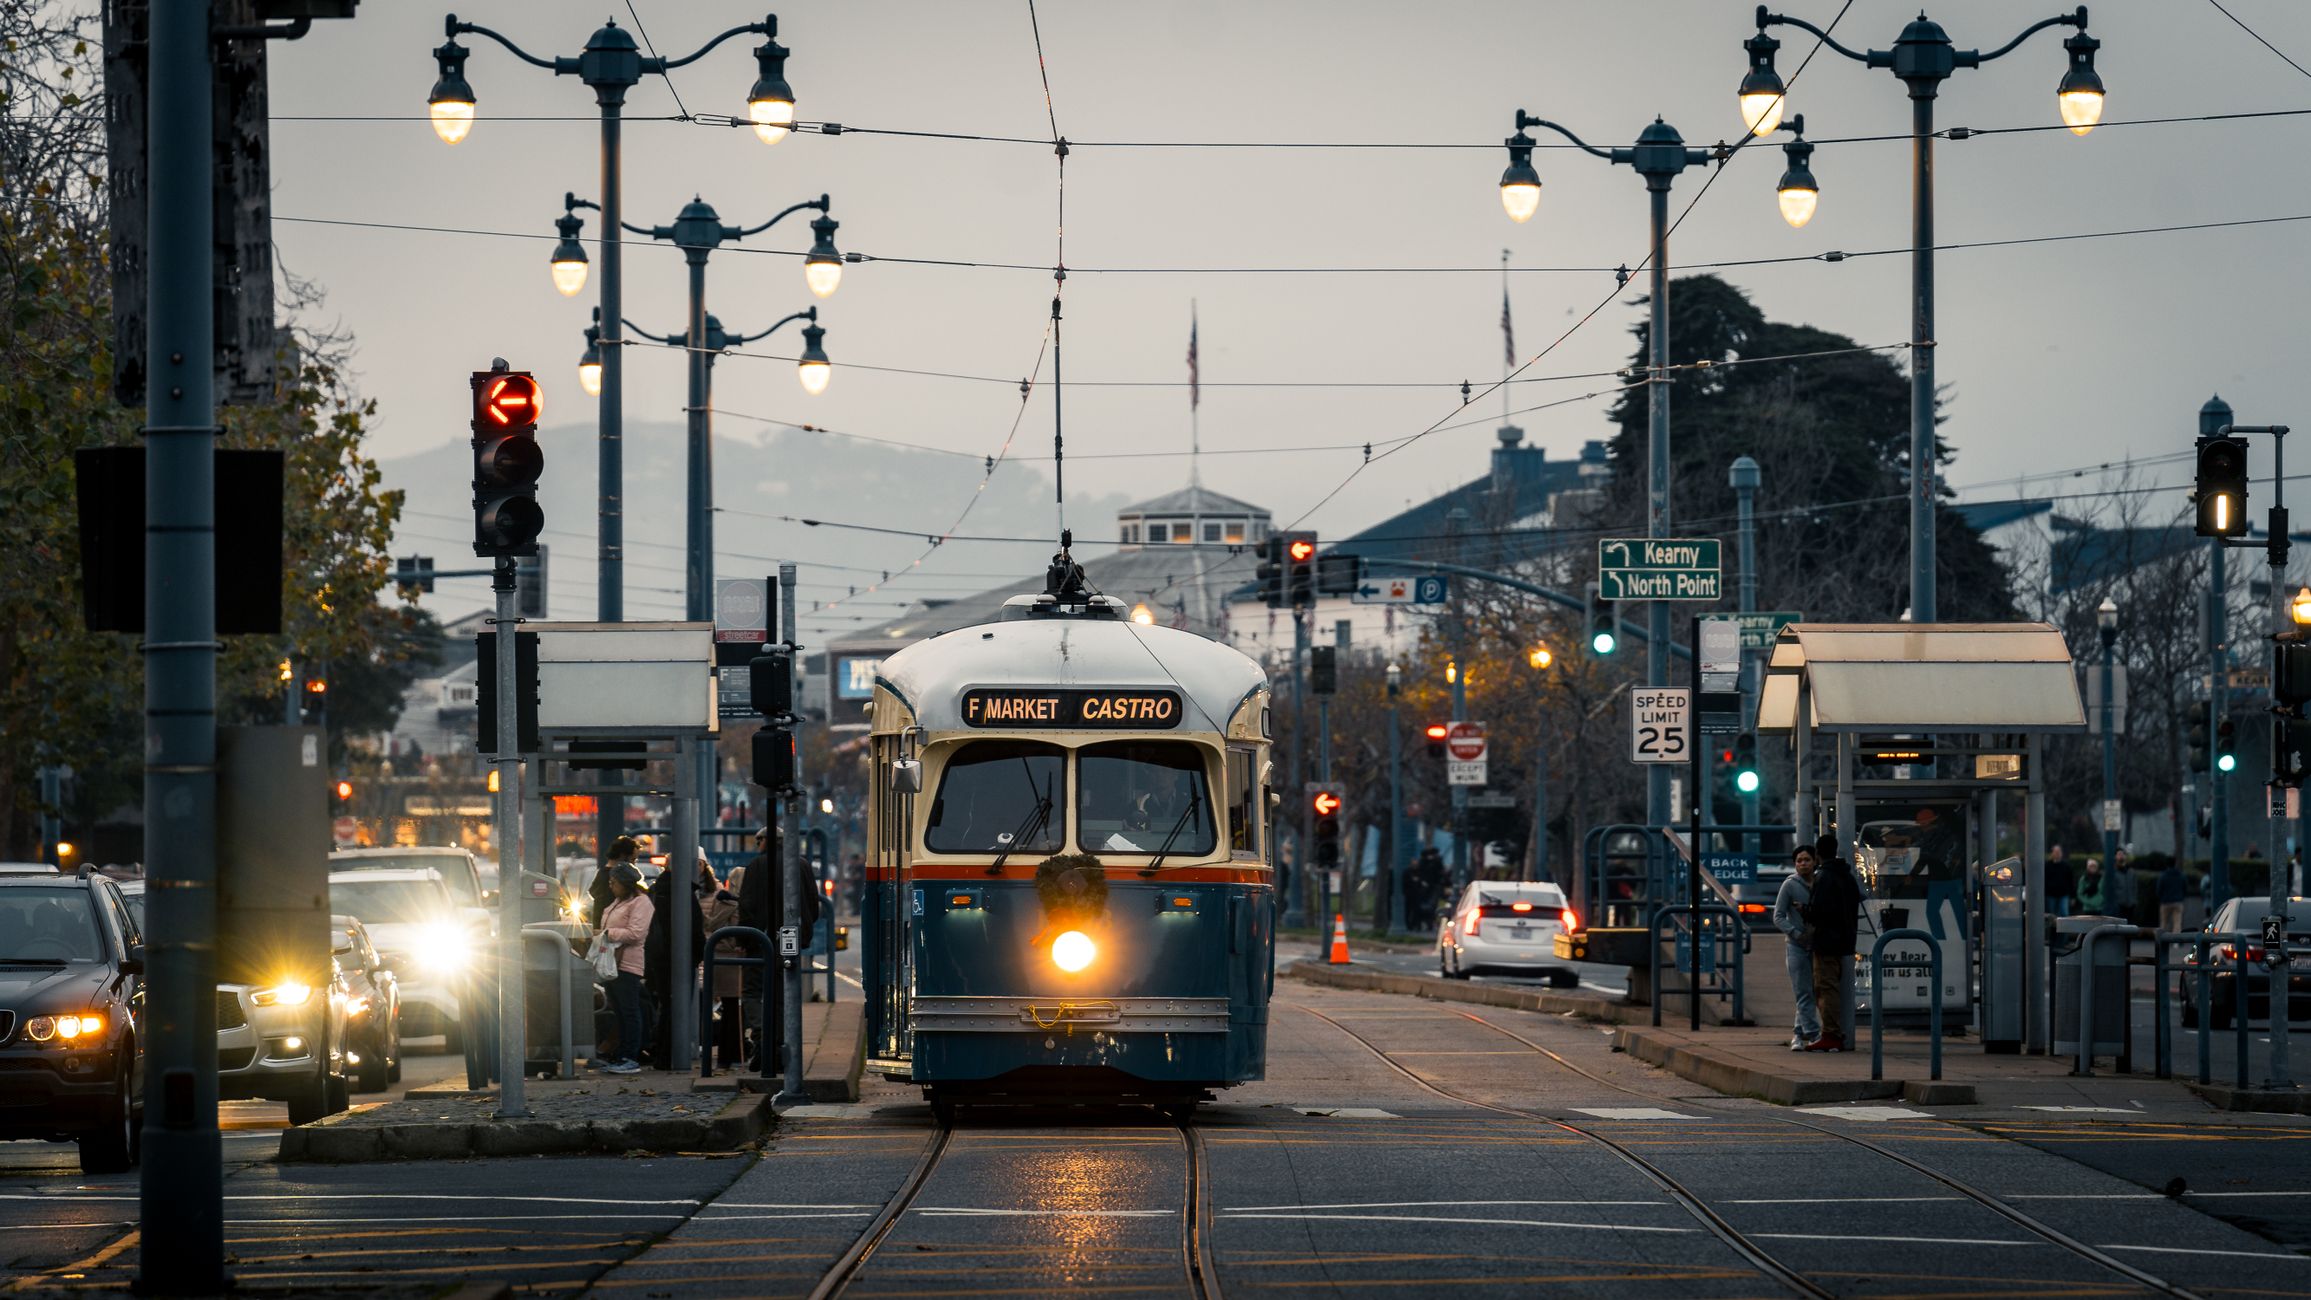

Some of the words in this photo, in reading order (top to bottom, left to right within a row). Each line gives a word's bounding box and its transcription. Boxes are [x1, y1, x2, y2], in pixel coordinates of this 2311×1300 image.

[1645, 542, 1700, 568] Kearny
[1628, 574, 1672, 595] North
[1677, 574, 1716, 595] Point
[723, 631, 759, 640] streetcar
[720, 669, 728, 681] F
[1636, 697, 1686, 708] SPEED
[969, 698, 980, 719] F
[987, 698, 1058, 719] MARKET
[1083, 697, 1172, 720] CASTRO
[1641, 712, 1680, 723] LIMIT
[1638, 727, 1685, 754] 25
[1711, 858, 1748, 867] BACK
[1714, 870, 1749, 879] EDGE
[1901, 951, 1927, 961] Bear
[1899, 968, 1911, 977] us
[1915, 967, 1932, 977] all
